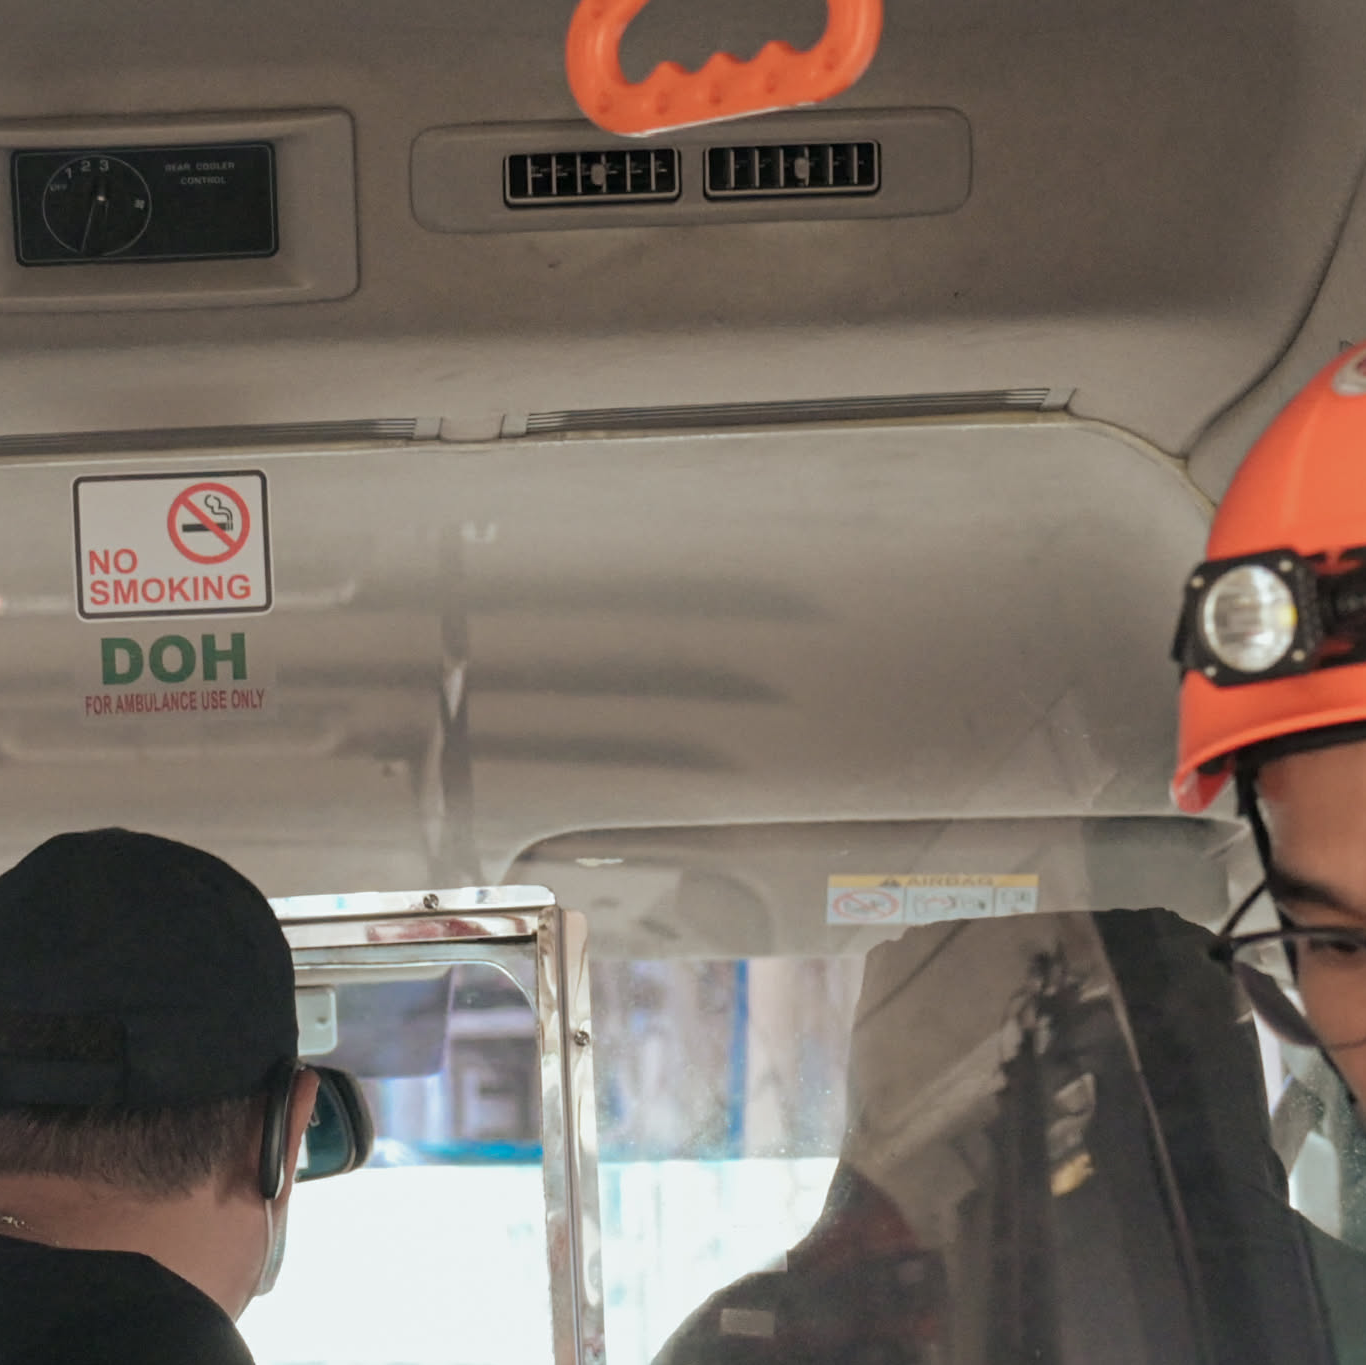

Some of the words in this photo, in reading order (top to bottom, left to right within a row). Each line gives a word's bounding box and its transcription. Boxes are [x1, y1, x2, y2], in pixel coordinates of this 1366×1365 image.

[81, 160, 92, 172] 2
[99, 159, 110, 172] 3
[195, 161, 236, 171] COOLER
[180, 176, 227, 186] CONTROL
[88, 548, 138, 576] NO
[90, 574, 252, 606] SMOKING
[100, 632, 248, 685] DOH
[85, 695, 112, 716] FOR
[116, 691, 198, 714] AMBULANCE
[201, 690, 228, 710] USE
[231, 688, 266, 710] ONLY
